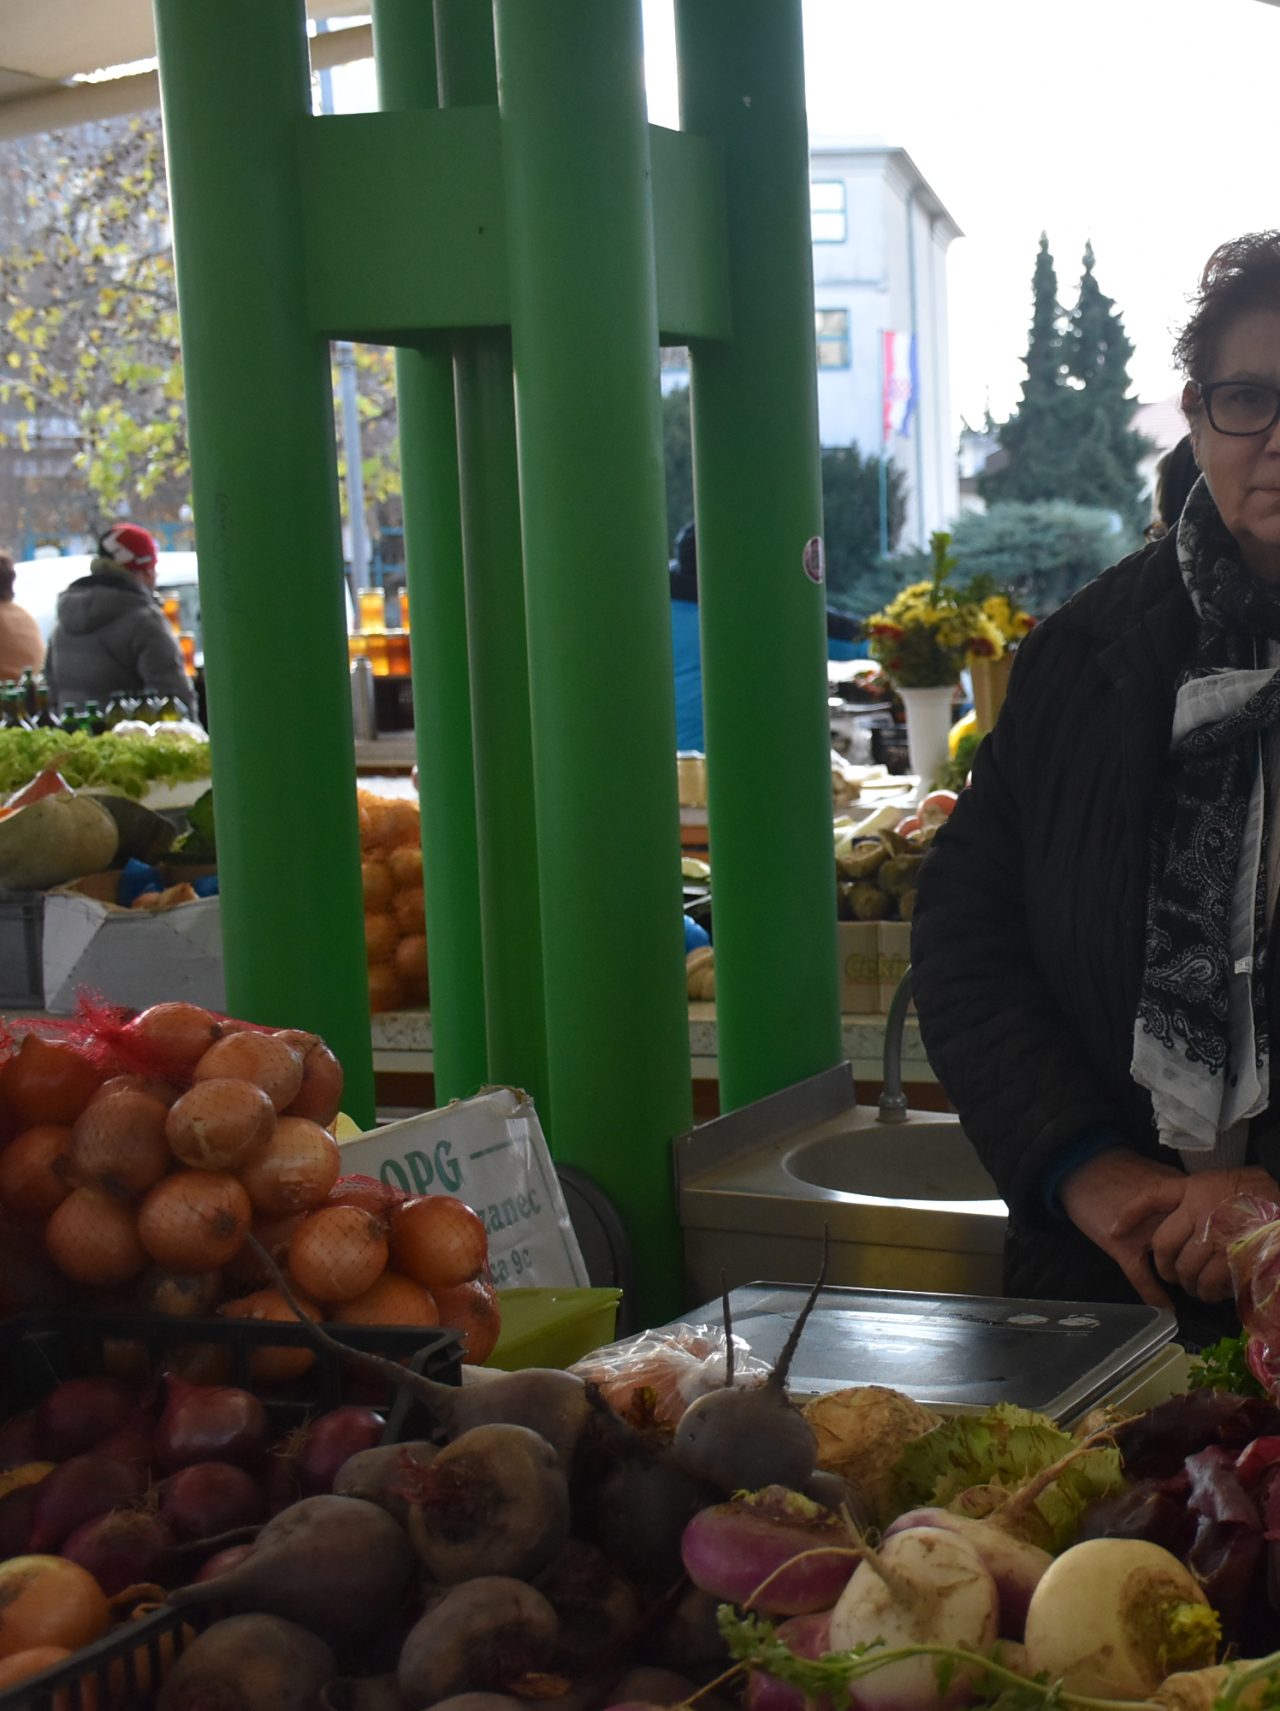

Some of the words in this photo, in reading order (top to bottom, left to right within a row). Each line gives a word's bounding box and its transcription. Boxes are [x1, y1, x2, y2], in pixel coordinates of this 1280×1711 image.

[381, 1140, 463, 1194] OPG
[478, 1189, 541, 1234] zanec
[489, 1260, 509, 1284] ca
